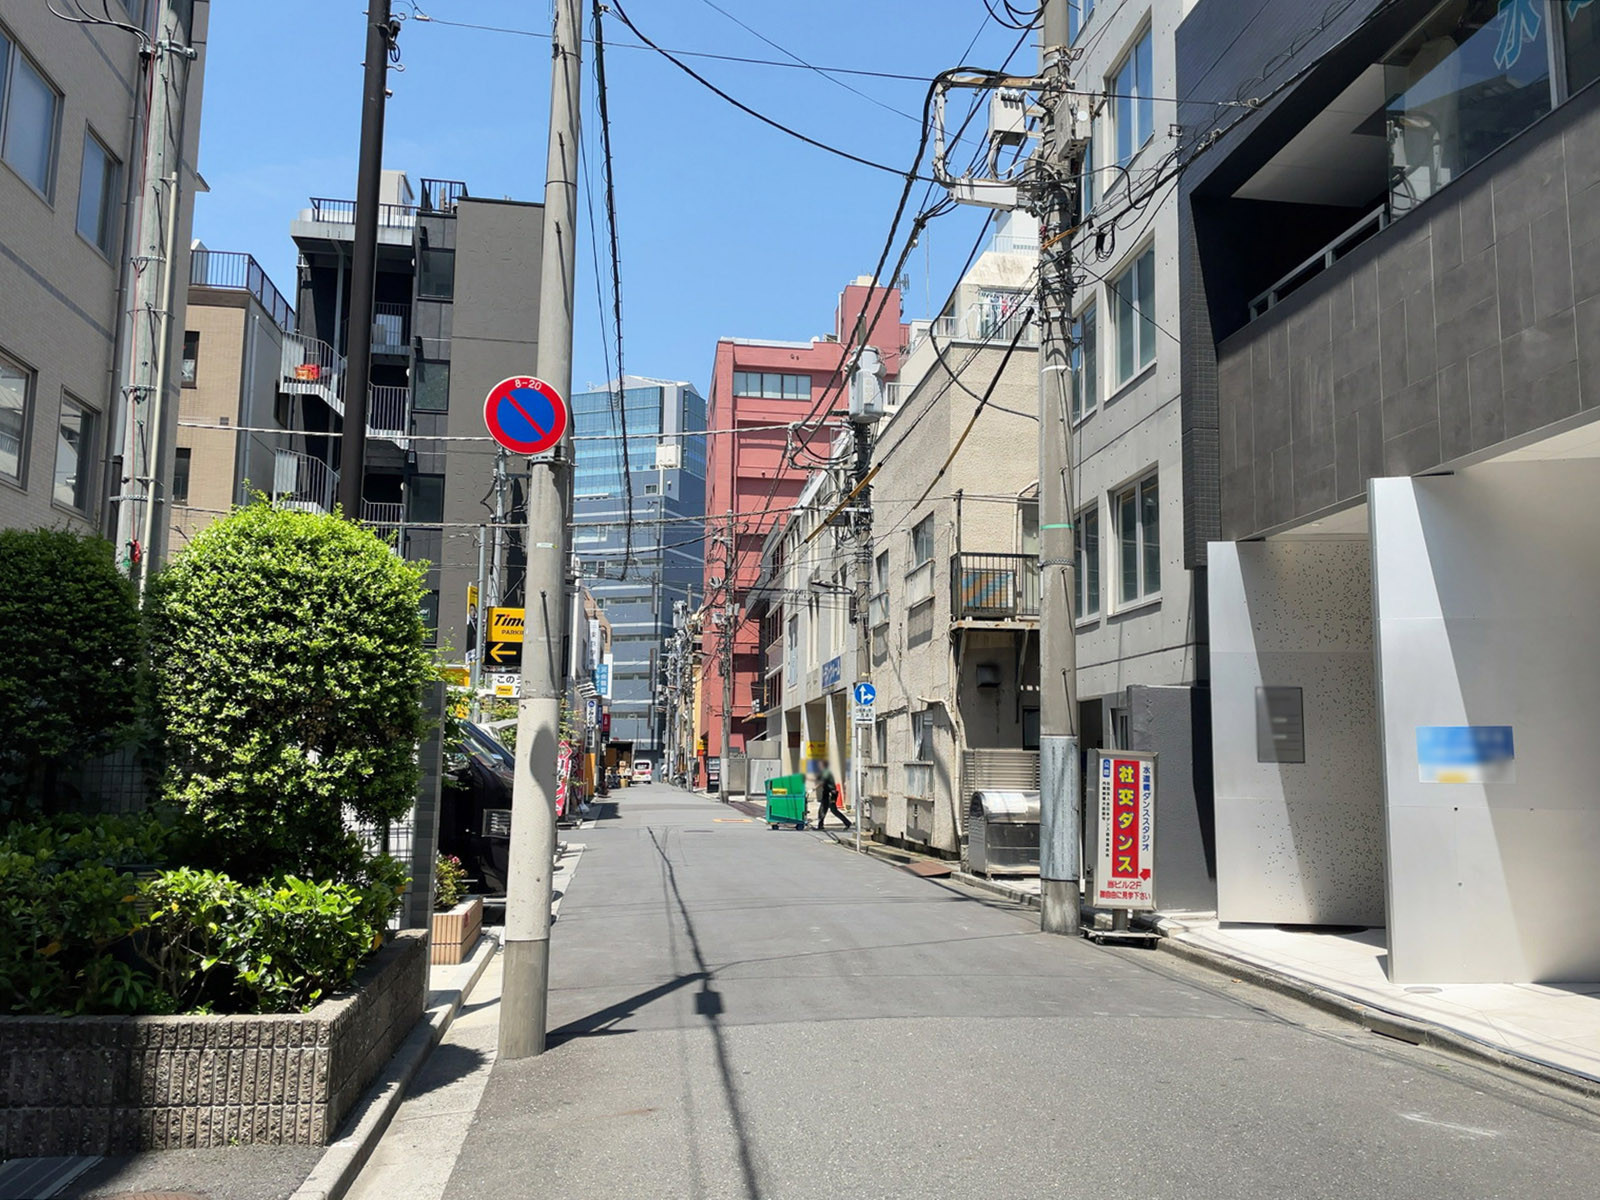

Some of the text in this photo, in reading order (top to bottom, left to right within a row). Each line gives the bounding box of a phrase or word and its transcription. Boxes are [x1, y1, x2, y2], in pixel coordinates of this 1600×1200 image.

[514, 379, 542, 391] 8-20
[1117, 765, 1134, 873] 社交ダンス
